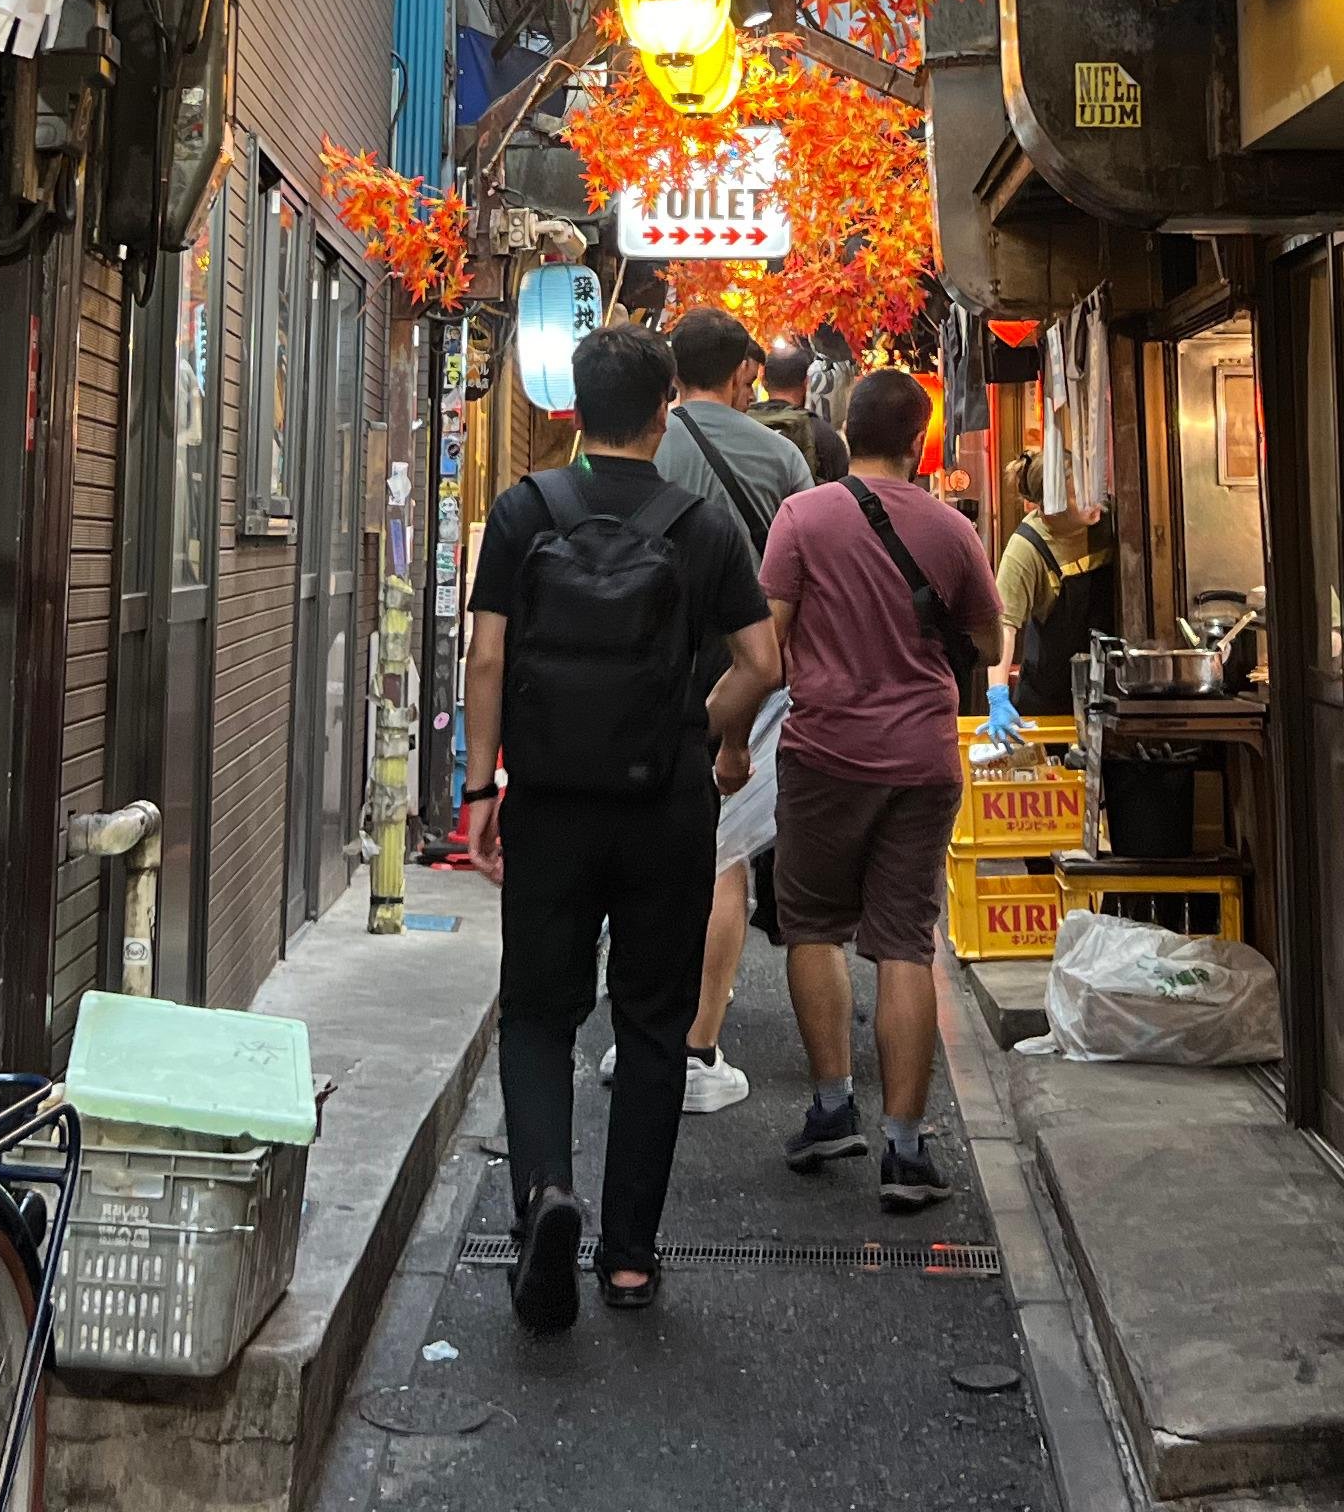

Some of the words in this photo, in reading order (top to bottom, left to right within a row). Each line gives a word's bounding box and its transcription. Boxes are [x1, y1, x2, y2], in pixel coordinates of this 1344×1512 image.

[1079, 105, 1138, 124] UDM
[573, 275, 595, 340] 築地
[983, 790, 1078, 819] KIRIN
[1006, 820, 1058, 832] キリンビール
[987, 904, 1057, 933] KIRI
[1011, 934, 1056, 945] キリンビー
